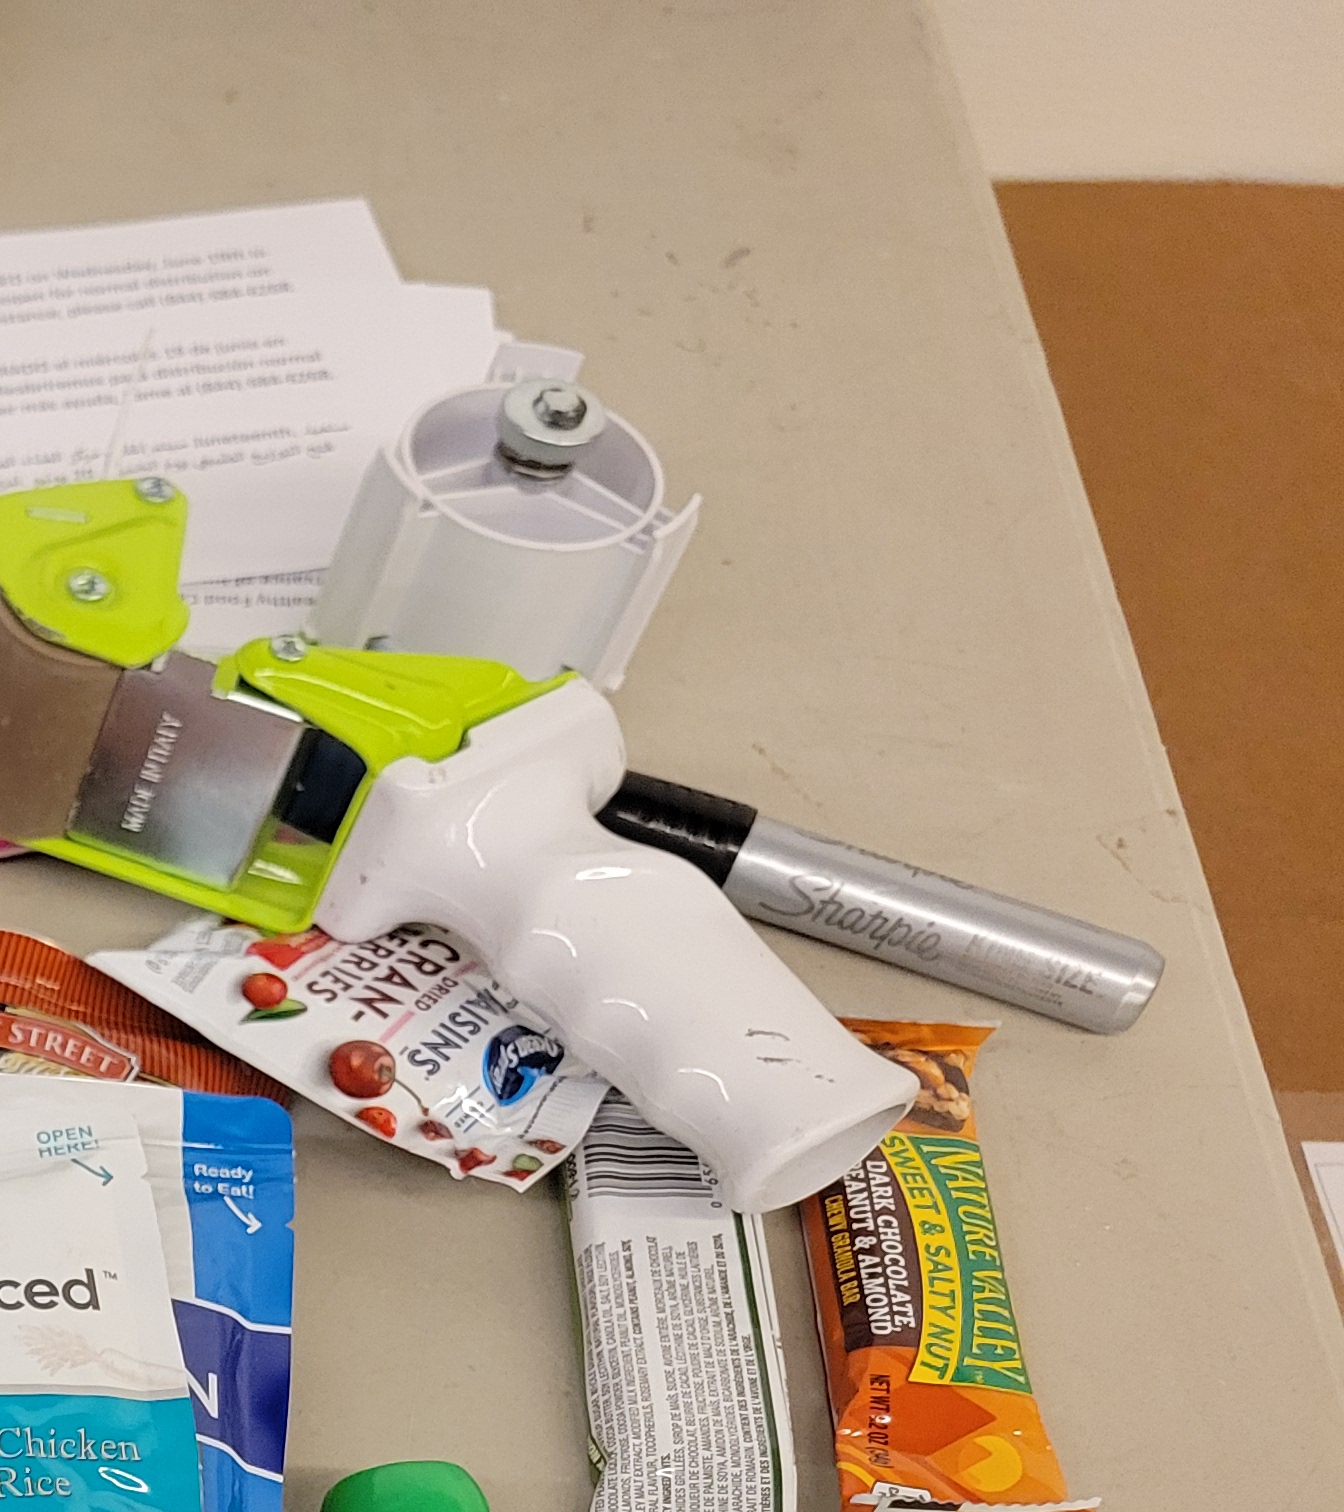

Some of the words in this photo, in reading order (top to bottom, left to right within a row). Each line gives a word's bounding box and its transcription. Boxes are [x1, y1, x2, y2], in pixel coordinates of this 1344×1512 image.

[120, 782, 156, 834] MADE
[758, 873, 946, 965] Sharpie
[413, 976, 460, 1012] DRIED
[8, 1021, 120, 1076] STREET
[36, 1125, 94, 1145] OPEN
[37, 1138, 101, 1159] HERE!
[193, 1163, 254, 1183] Ready
[193, 1181, 213, 1195] to
[217, 1181, 255, 1199] Eat!
[865, 1160, 896, 1213] DARK
[881, 1135, 940, 1215] SWEET
[825, 1195, 847, 1231] CHEWY
[919, 1218, 944, 1236] &
[831, 1231, 855, 1285] GRANOLA
[854, 1235, 878, 1251] &
[920, 1142, 997, 1261] NATURE
[963, 1259, 1025, 1382] VALLEY
[858, 1254, 893, 1336] ALMOND
[877, 1215, 916, 1332] CHOCOLATE,
[921, 1245, 959, 1323] SALTY
[919, 1326, 955, 1381] NUT
[869, 1374, 891, 1394] NET
[869, 1396, 890, 1413] WT
[759, 1460, 769, 1473] DES
